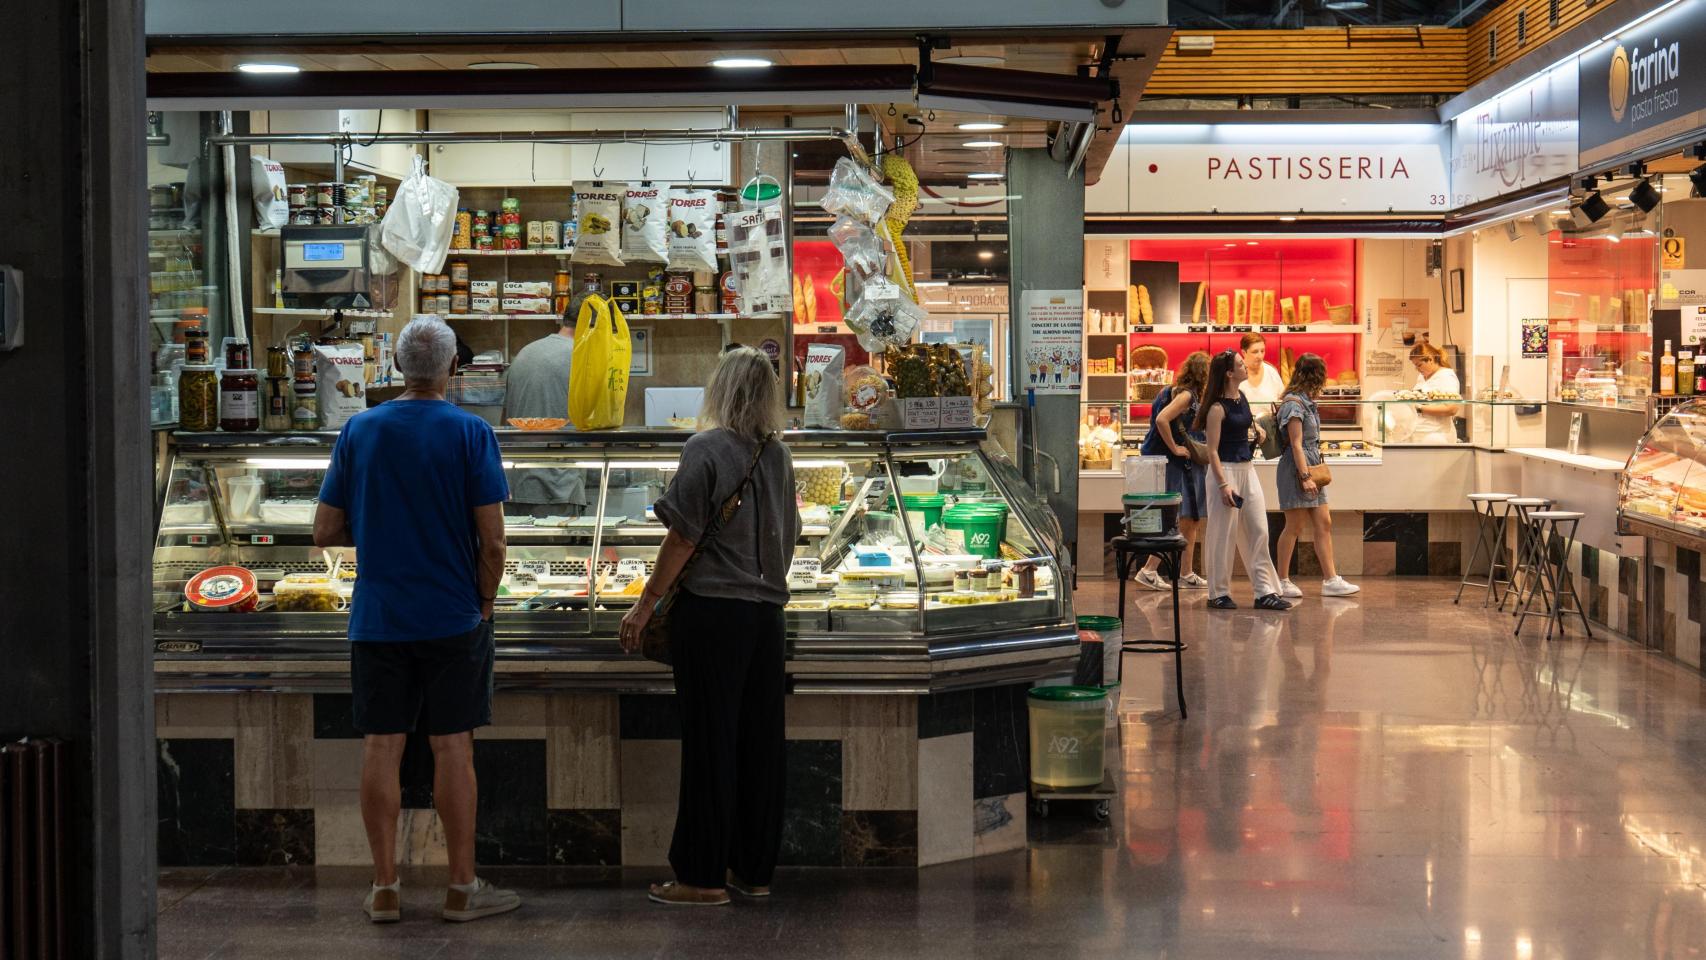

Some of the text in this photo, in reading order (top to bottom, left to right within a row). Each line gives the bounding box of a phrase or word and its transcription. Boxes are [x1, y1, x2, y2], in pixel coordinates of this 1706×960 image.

[1631, 38, 1679, 96] farina
[1631, 88, 1679, 128] pasta fresca
[1207, 157, 1410, 180] PASTISSERIA
[576, 192, 617, 201] TORRES
[671, 198, 707, 208] TORRES
[1429, 194, 1446, 205] 33
[1664, 238, 1681, 259] Q
[328, 356, 363, 366] TORRES
[807, 354, 832, 364] TORRES
[970, 532, 990, 545] A92
[1048, 735, 1079, 754] A92
